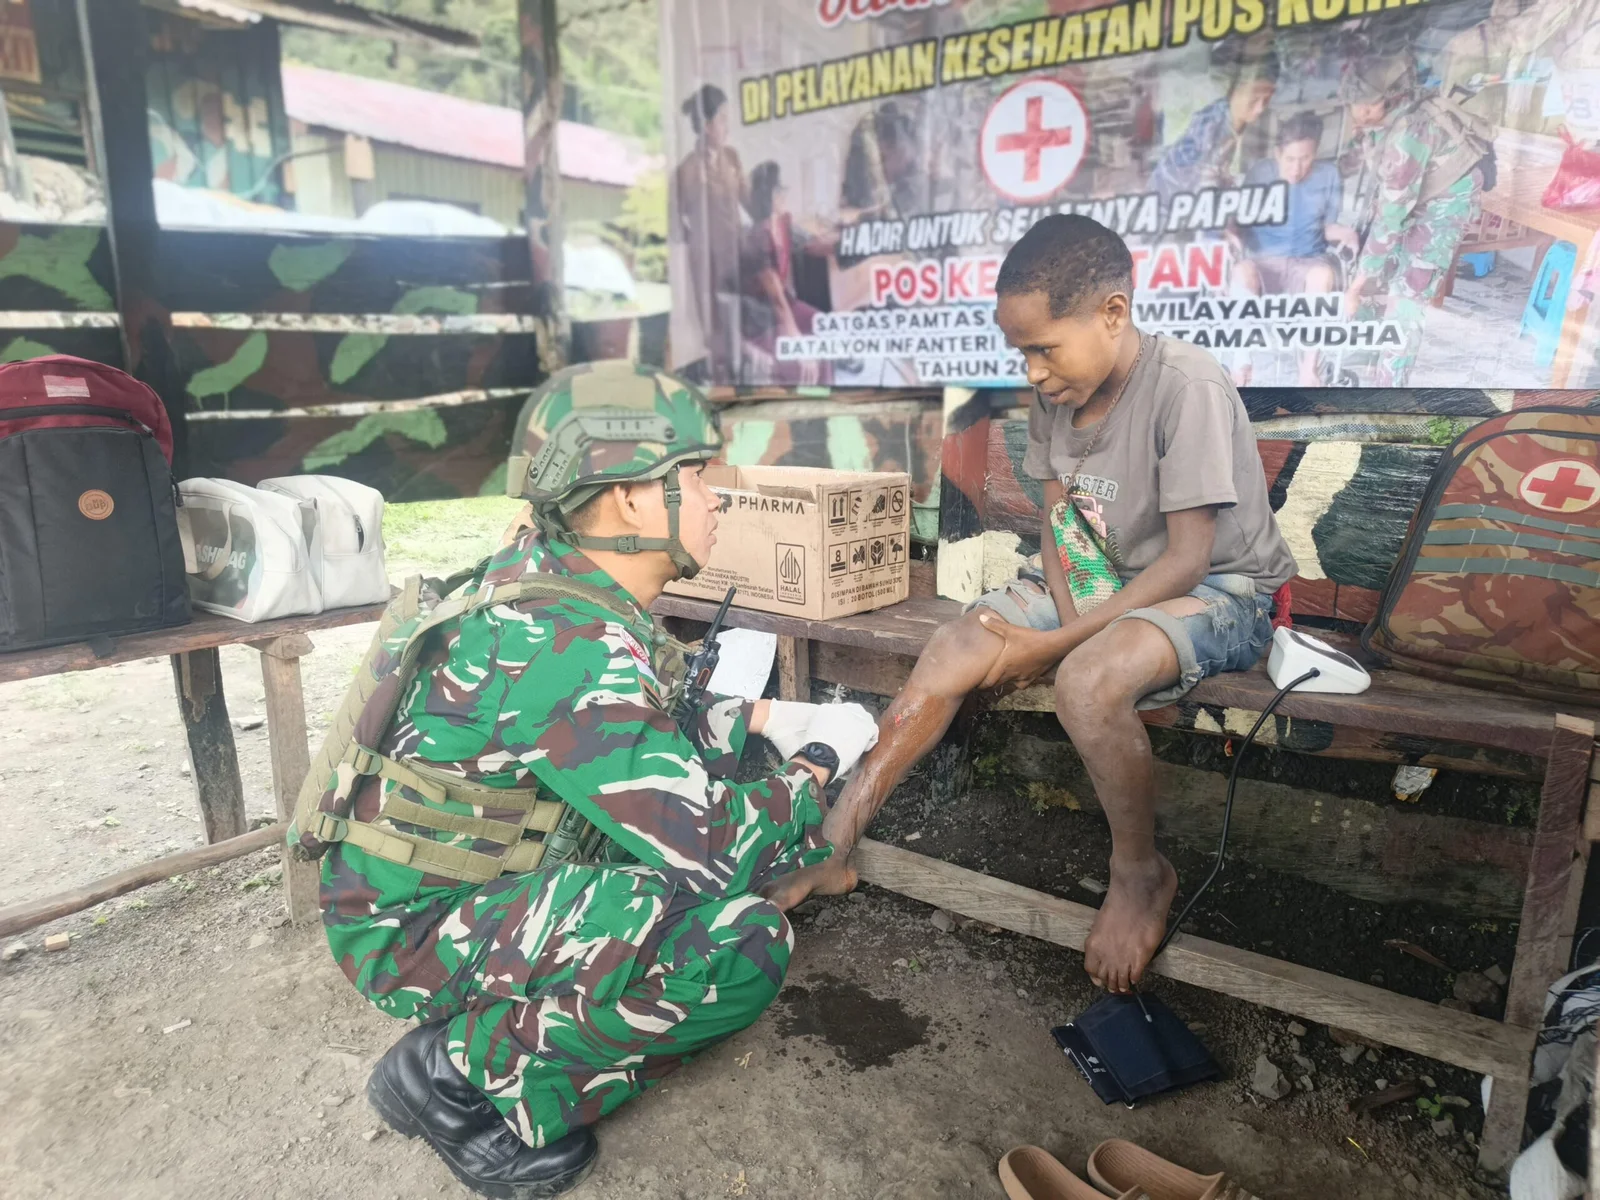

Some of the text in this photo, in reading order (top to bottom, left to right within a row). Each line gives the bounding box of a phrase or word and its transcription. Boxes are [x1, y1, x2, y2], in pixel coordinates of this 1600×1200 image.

[741, 77, 770, 124] DI
[774, 40, 938, 117] PELAYANAN
[941, 0, 1162, 83] KESEHATAN
[1171, 0, 1265, 45] POS
[839, 221, 904, 256] HADIR
[907, 211, 990, 249] UNTUK
[1168, 183, 1287, 230] PAPUA
[874, 263, 939, 302] POS
[816, 312, 891, 332] SATGAS
[896, 310, 986, 330] PAMTAS
[780, 338, 880, 355] BATALYON
[886, 335, 996, 353] INFANTERI
[1276, 325, 1401, 347] YUDHA
[919, 360, 999, 377] TAHUN
[739, 496, 805, 515] PHARMA
[835, 550, 841, 562] 8
[780, 585, 802, 594] HALAL
